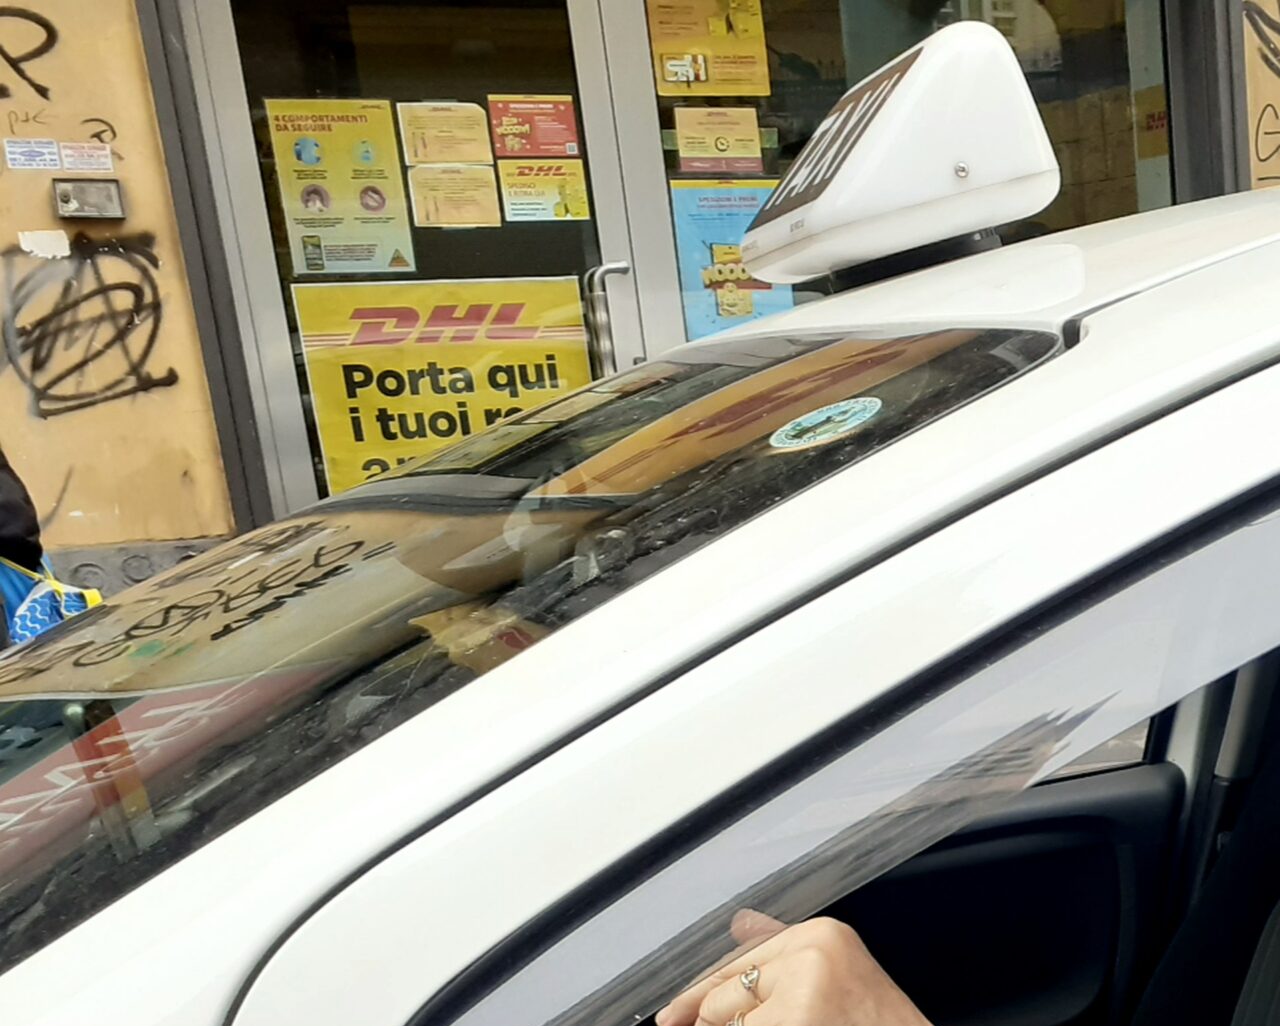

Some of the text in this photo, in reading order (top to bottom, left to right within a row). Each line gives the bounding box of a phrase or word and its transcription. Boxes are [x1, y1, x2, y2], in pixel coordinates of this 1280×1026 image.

[763, 71, 901, 211] TAXI
[515, 165, 569, 177] DHL
[349, 302, 541, 346] DHL
[342, 354, 560, 399] Porta qui
[349, 406, 365, 442] i
[376, 402, 471, 441] tuoi
